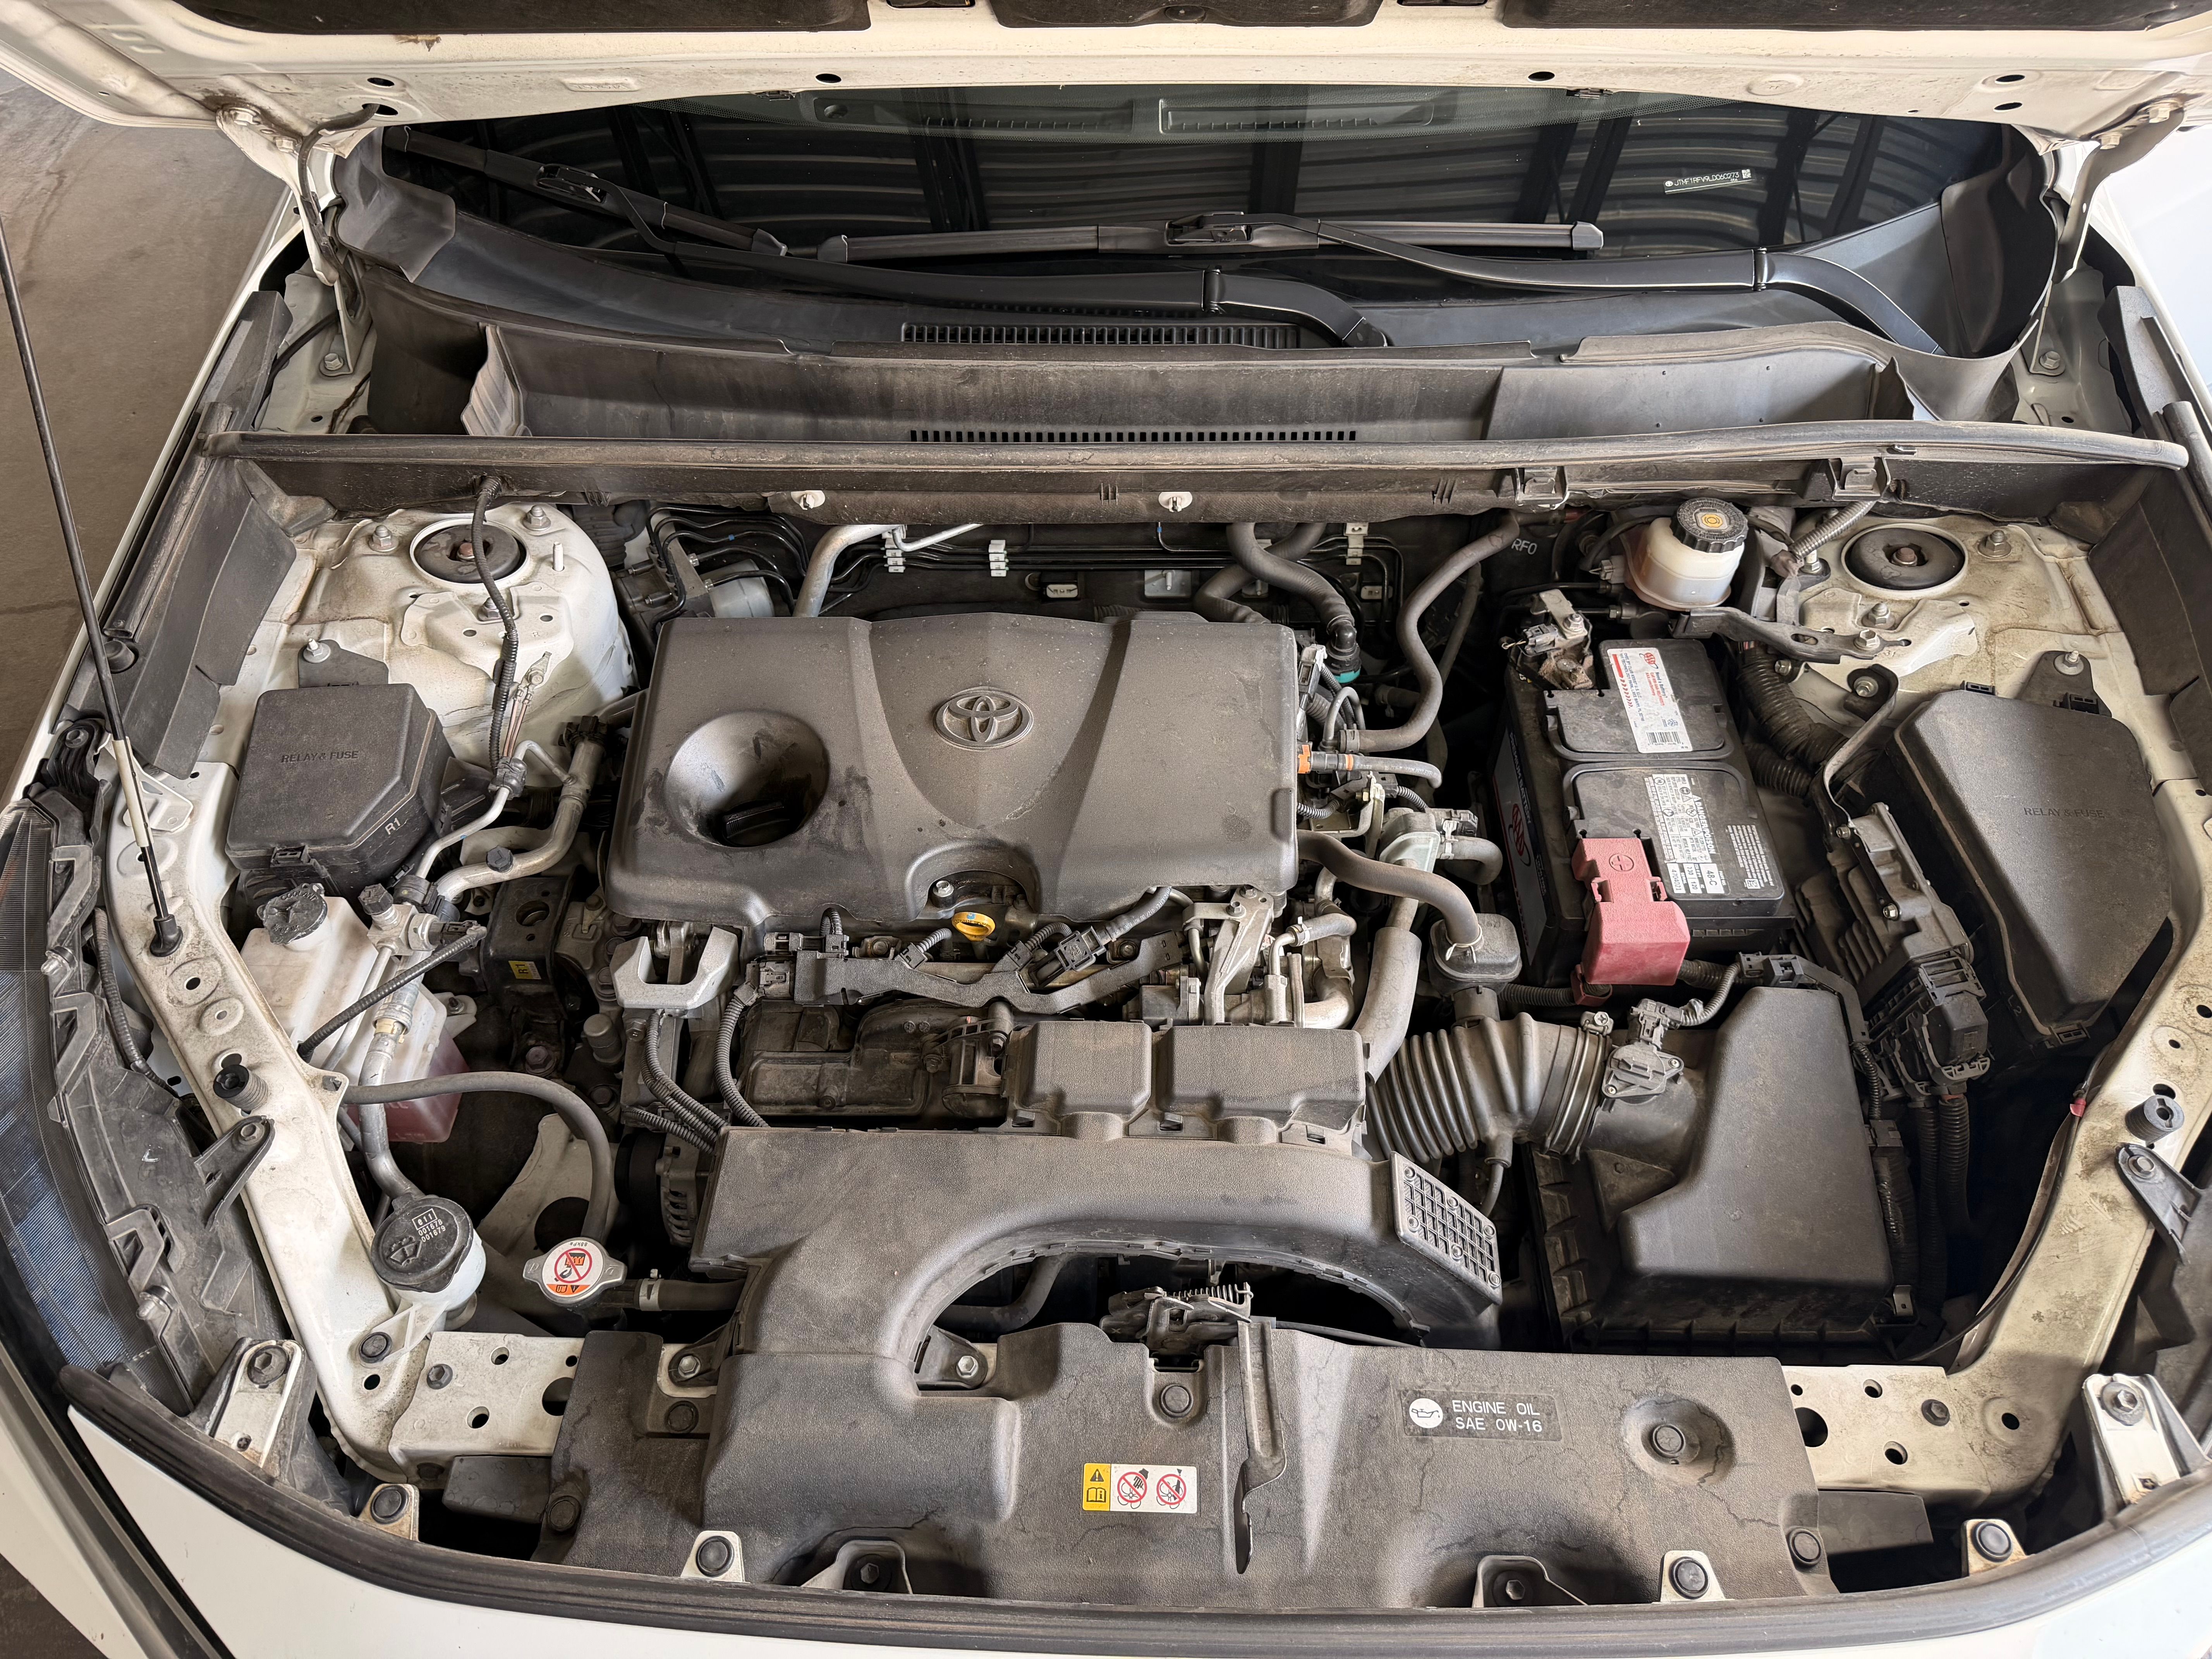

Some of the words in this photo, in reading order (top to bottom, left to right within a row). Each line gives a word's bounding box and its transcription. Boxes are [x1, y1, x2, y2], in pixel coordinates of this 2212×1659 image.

[1658, 684, 1668, 698] Battery?
[281, 753, 318, 763] RELAY
[330, 750, 359, 759] FUSE
[1519, 777, 1531, 824] BATTERY
[2023, 807, 2060, 816] RELAY
[2075, 809, 2105, 818] FUSE
[385, 817, 402, 835] R1
[1694, 802, 1716, 854] DANGER/POISON
[1686, 866, 1694, 875] 730
[1705, 870, 1717, 885] 48-C
[1671, 869, 1682, 890] 4704021
[281, 890, 319, 902] COOLANT
[515, 964, 529, 974] R1
[417, 1214, 433, 1226] e11
[419, 1219, 443, 1236] 001678
[421, 1225, 446, 1242] 001679
[1452, 1400, 1506, 1414] ENGINE
[1516, 1403, 1540, 1415] OIL
[1456, 1417, 1486, 1430] SAE
[1496, 1419, 1542, 1432] 0W-16
